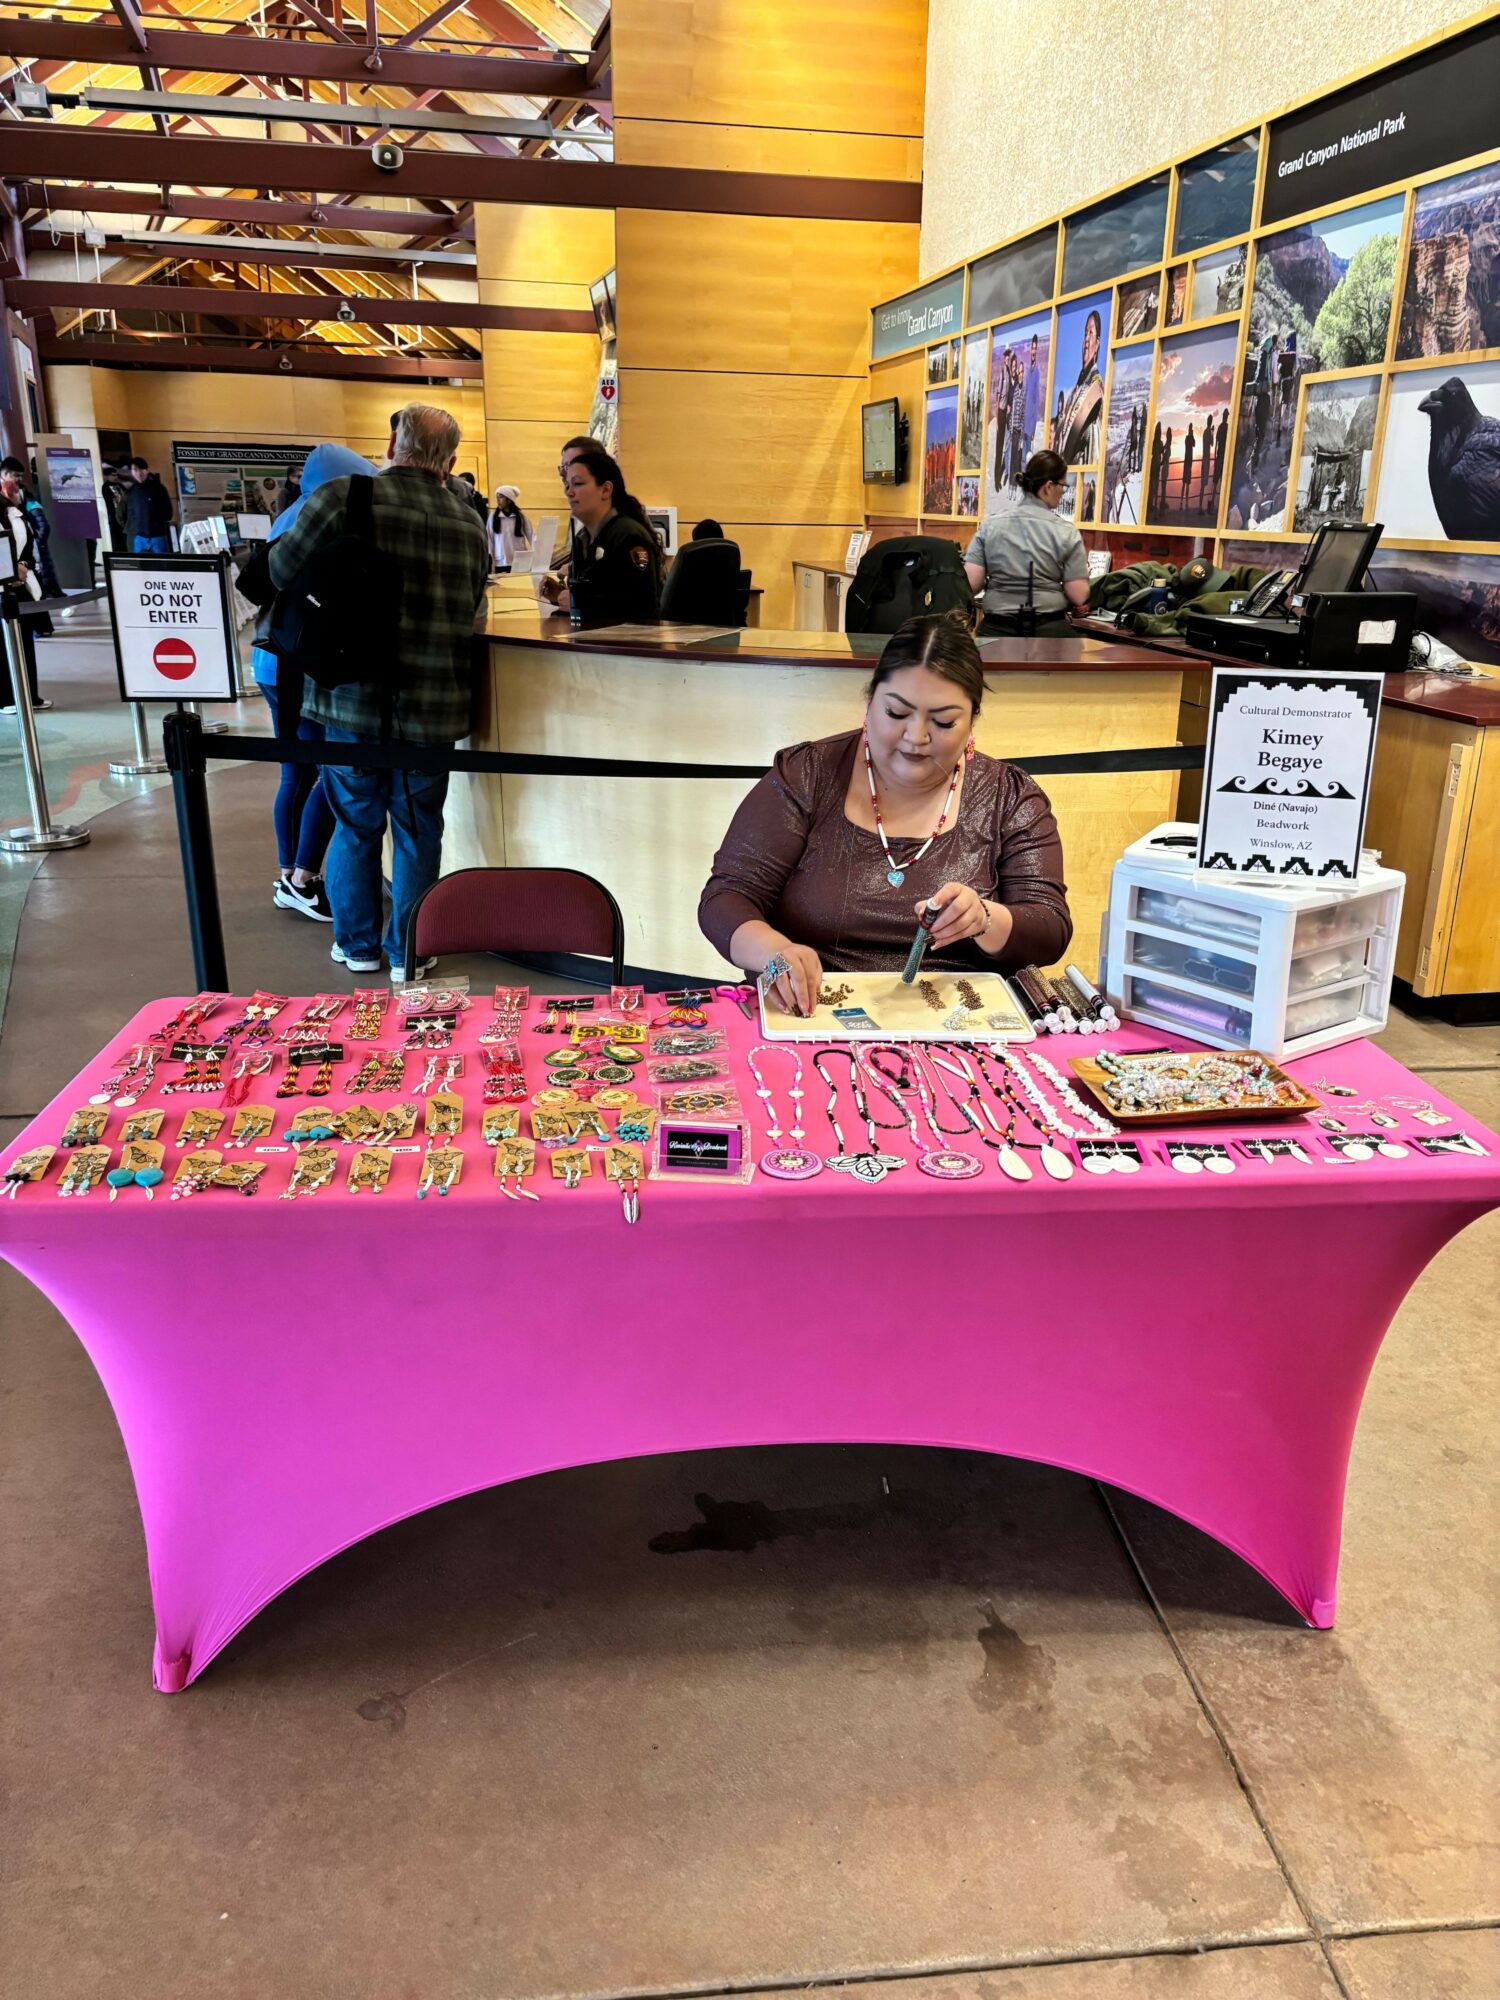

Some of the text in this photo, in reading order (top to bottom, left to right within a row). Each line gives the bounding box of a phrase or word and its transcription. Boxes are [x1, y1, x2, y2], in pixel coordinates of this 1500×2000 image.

[1278, 112, 1407, 178] Grand Canyon National Park
[881, 307, 912, 331] Get to know
[907, 304, 954, 337] Grand Canyon
[177, 449, 206, 457] FOSSILS
[217, 450, 244, 458] GRAND
[244, 451, 275, 459] CANYON
[144, 581, 195, 591] ONE WAY
[140, 594, 203, 607] DO NOT
[149, 611, 198, 623] ENTER
[1239, 705, 1353, 719] Cultural Demonstrator
[1262, 728, 1324, 751] Kimey
[1257, 751, 1323, 773] Begaye
[1253, 801, 1318, 814] Diné (Navajo)
[1256, 819, 1310, 831] Beadwork
[1250, 838, 1313, 851] Winslow, AZ
